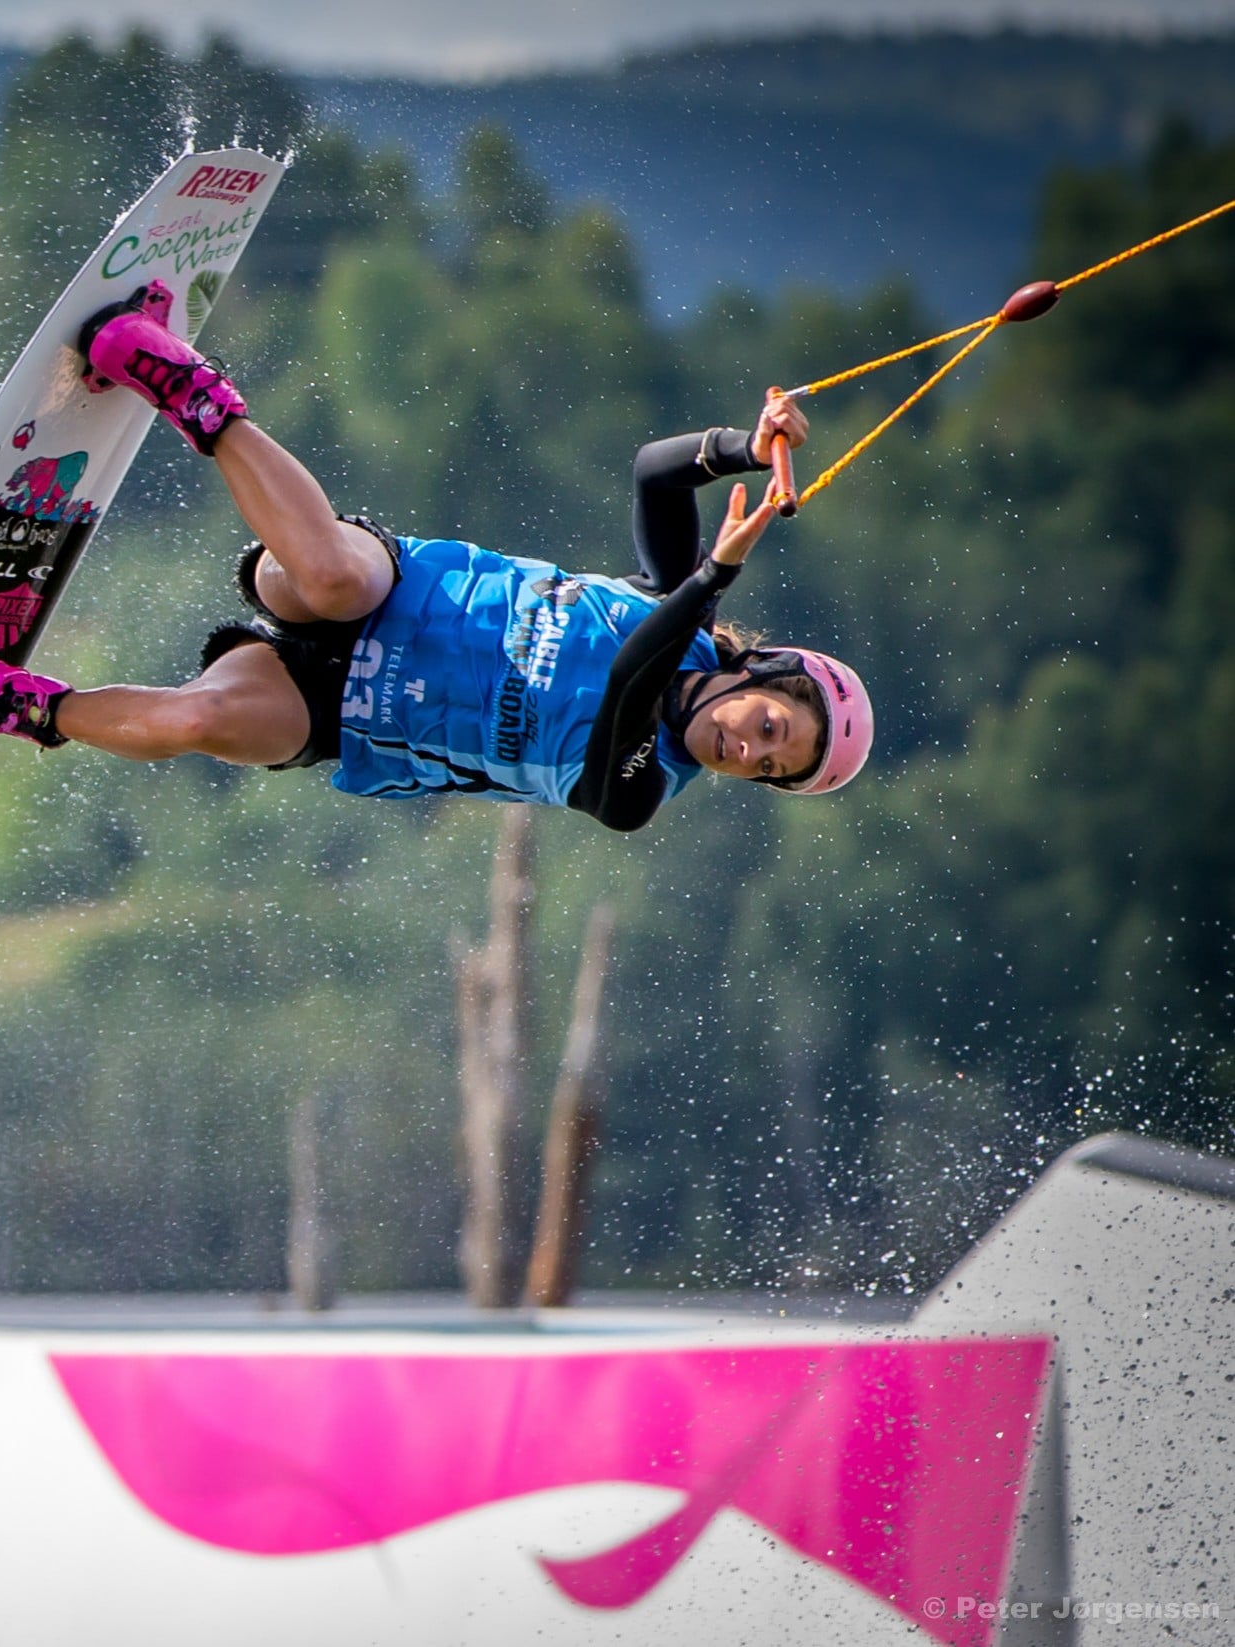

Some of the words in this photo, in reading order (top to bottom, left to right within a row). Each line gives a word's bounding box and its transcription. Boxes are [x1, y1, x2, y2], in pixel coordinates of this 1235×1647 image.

[177, 166, 267, 197] RIXEN
[101, 207, 257, 279] Coconut
[380, 644, 405, 725] TELEMARK
[528, 606, 571, 692] CABLE
